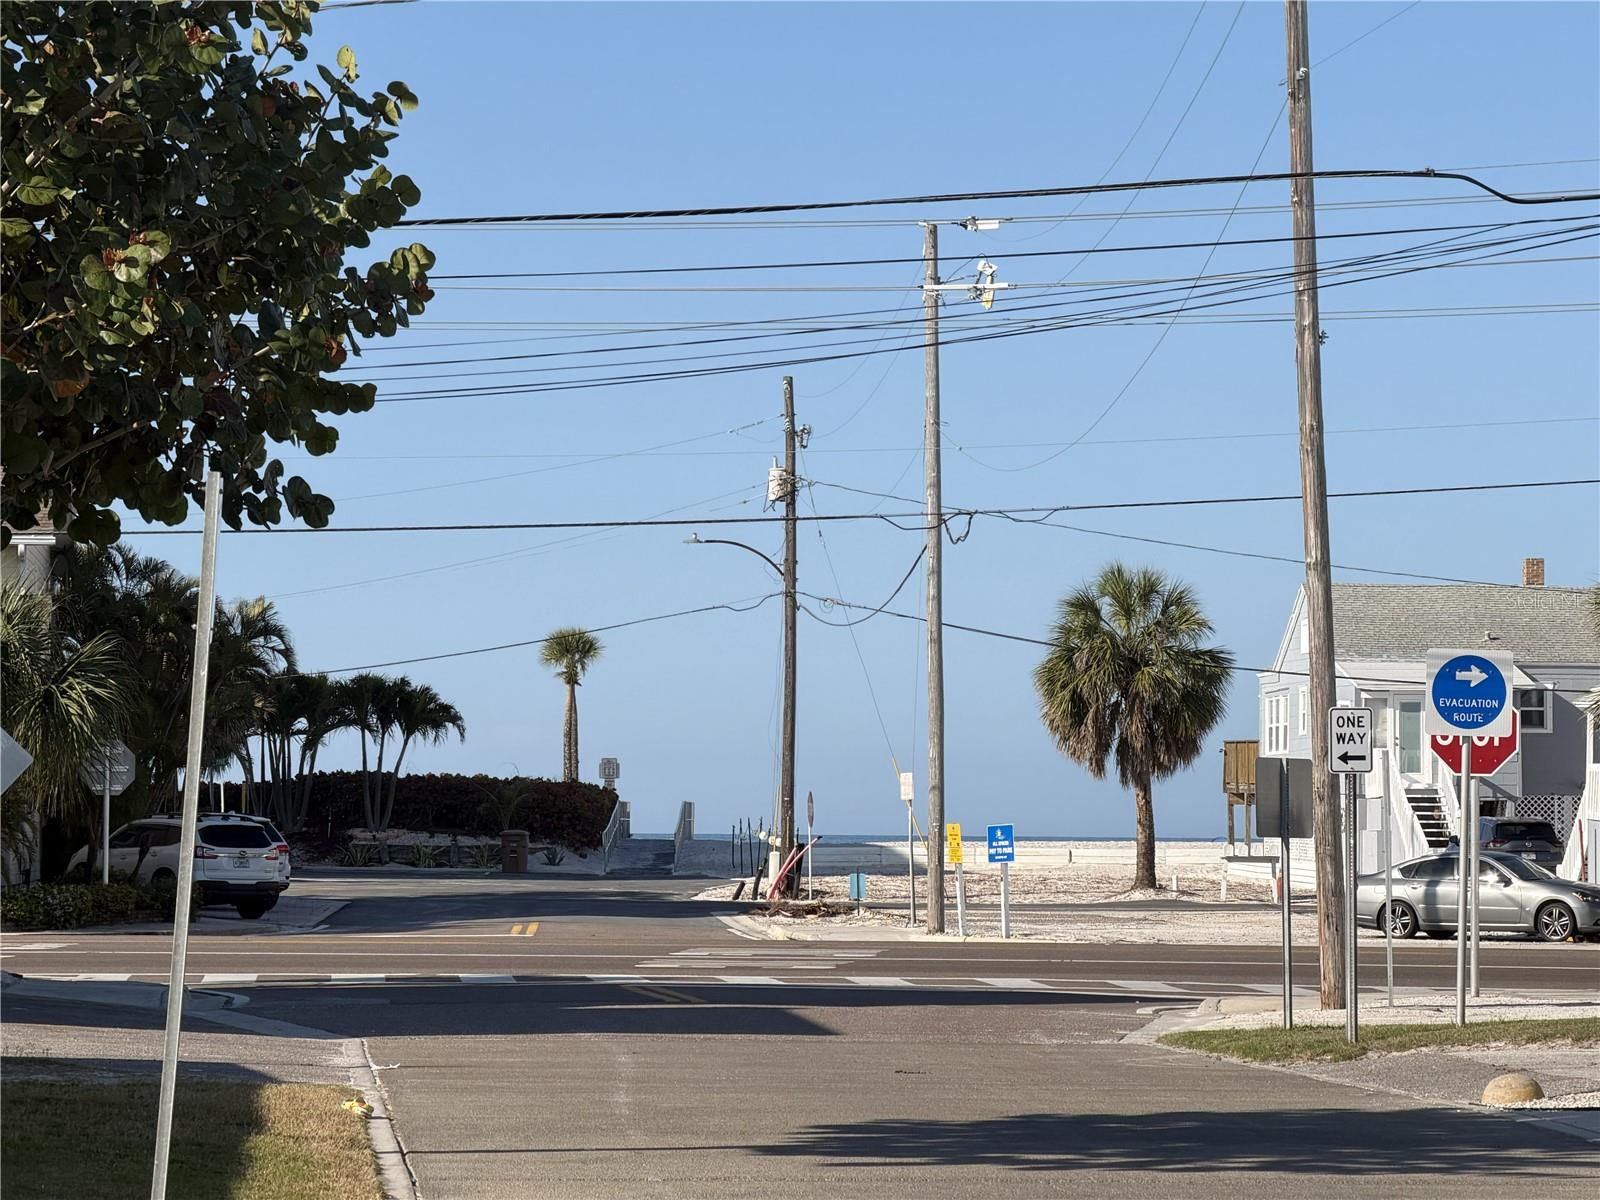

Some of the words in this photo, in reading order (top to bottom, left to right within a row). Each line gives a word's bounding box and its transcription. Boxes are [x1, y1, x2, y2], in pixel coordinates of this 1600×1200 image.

[1439, 698, 1499, 708] EVACUATION
[1336, 715, 1365, 728] ONE
[1453, 713, 1484, 723] ROUTE
[1335, 732, 1367, 745] WAY
